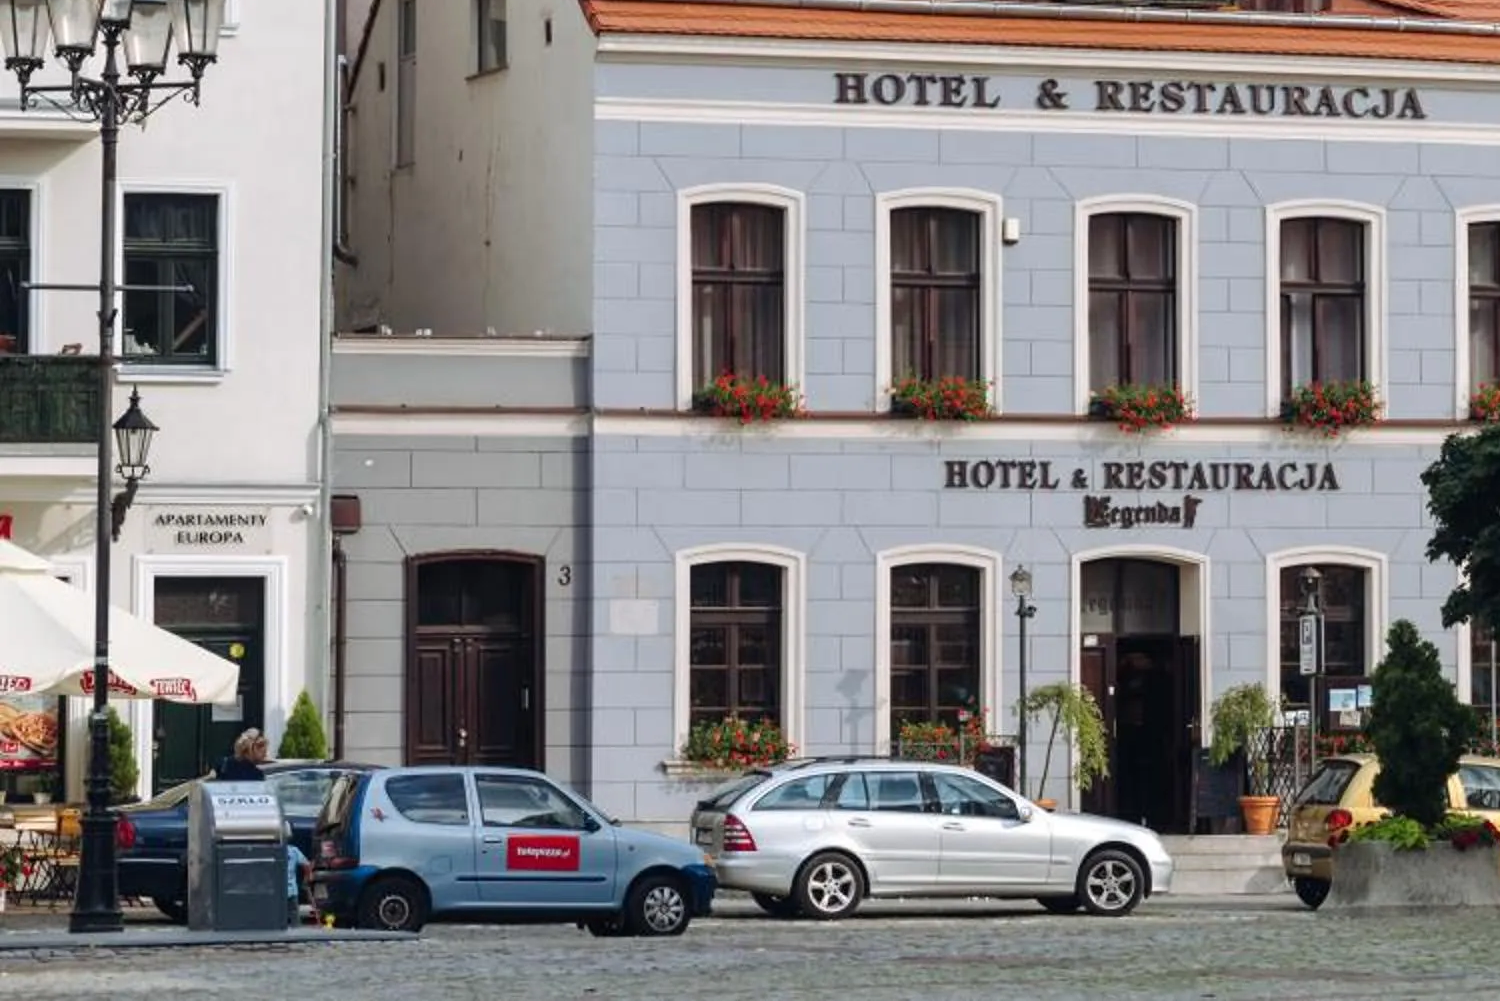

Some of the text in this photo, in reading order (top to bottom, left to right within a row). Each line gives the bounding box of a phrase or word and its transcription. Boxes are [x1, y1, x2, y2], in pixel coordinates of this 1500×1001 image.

[834, 72, 1426, 120] HOTEL & RESTAURACJA
[943, 460, 1341, 492] HOTEL & RESTAURACJA
[155, 514, 267, 526] APARTAMENTY
[1083, 495, 1182, 528] Legenda
[177, 530, 244, 543] EUROPA
[558, 565, 571, 586] 3
